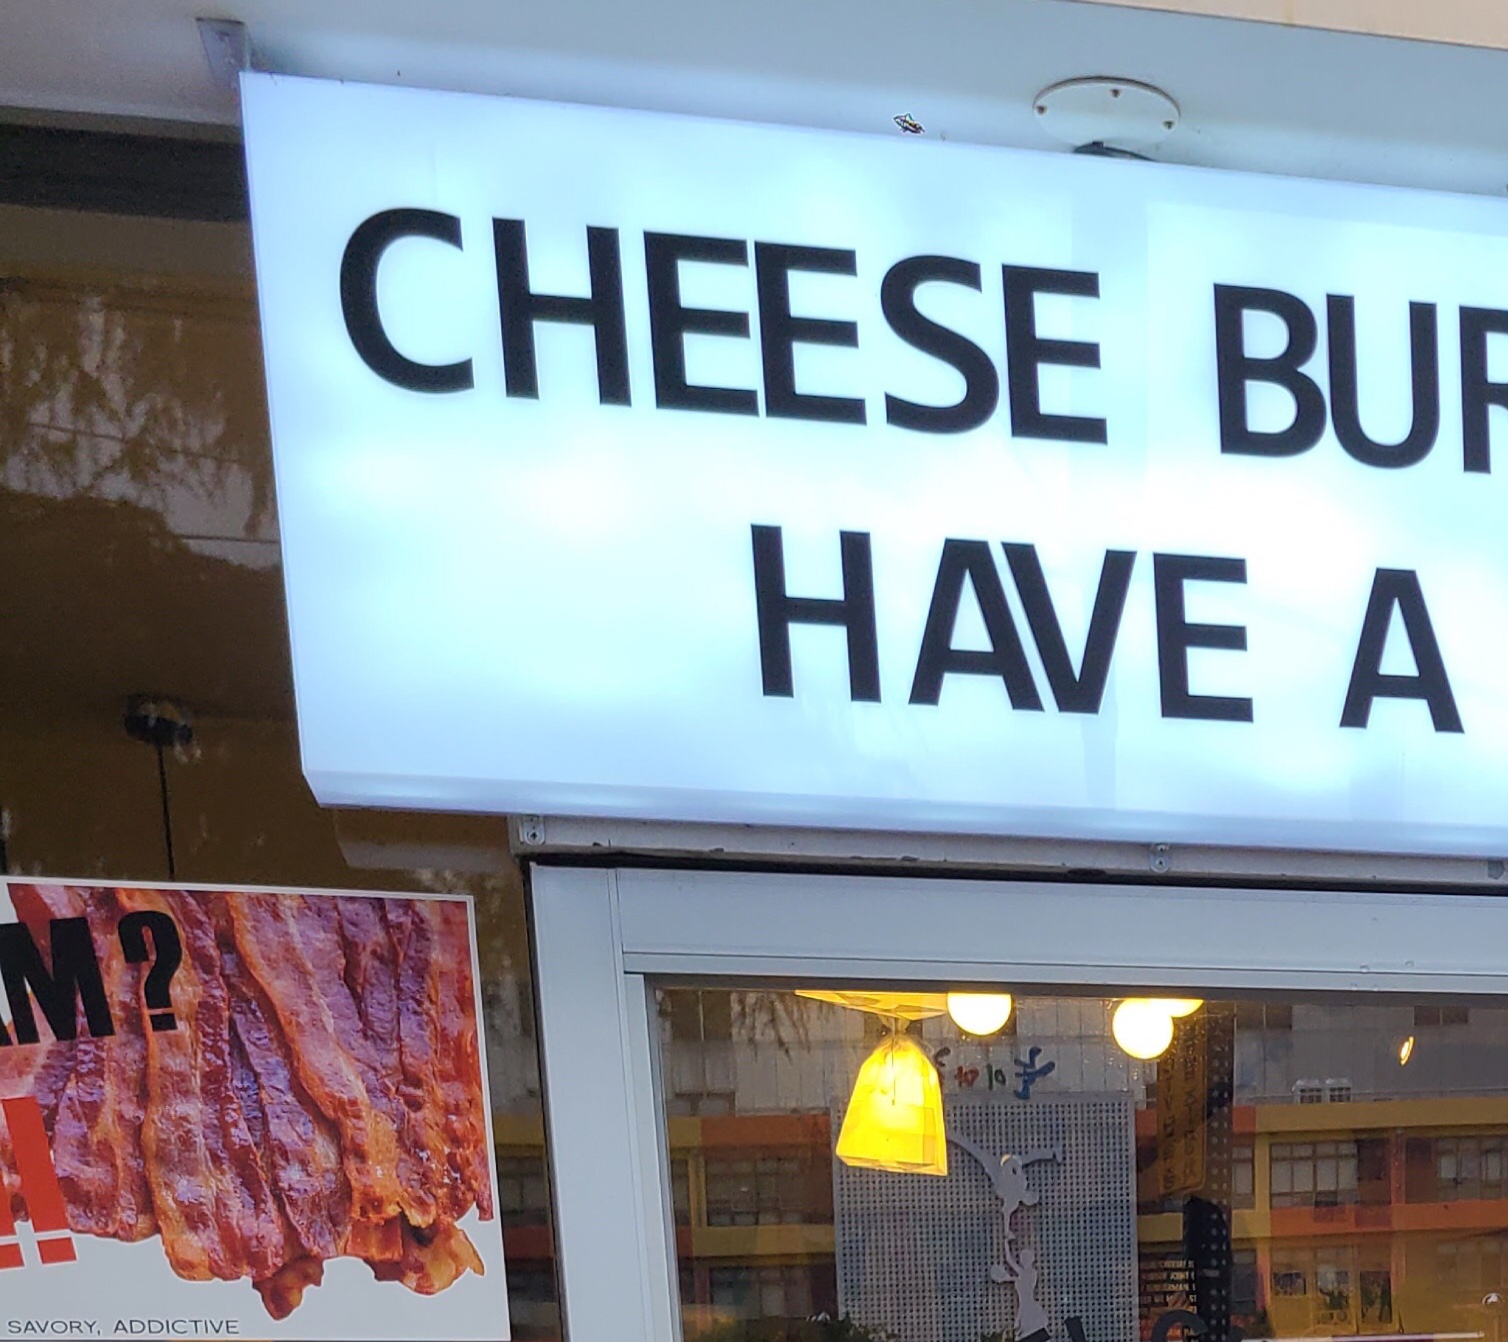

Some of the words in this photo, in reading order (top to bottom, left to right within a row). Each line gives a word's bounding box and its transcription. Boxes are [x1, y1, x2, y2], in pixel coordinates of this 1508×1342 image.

[340, 207, 1108, 445] CHEESE
[750, 523, 1254, 723] HAVE
[1339, 567, 1466, 735] A
[8, 1319, 101, 1336] SAVORY,
[114, 1319, 240, 1334] ADDICTIVE
